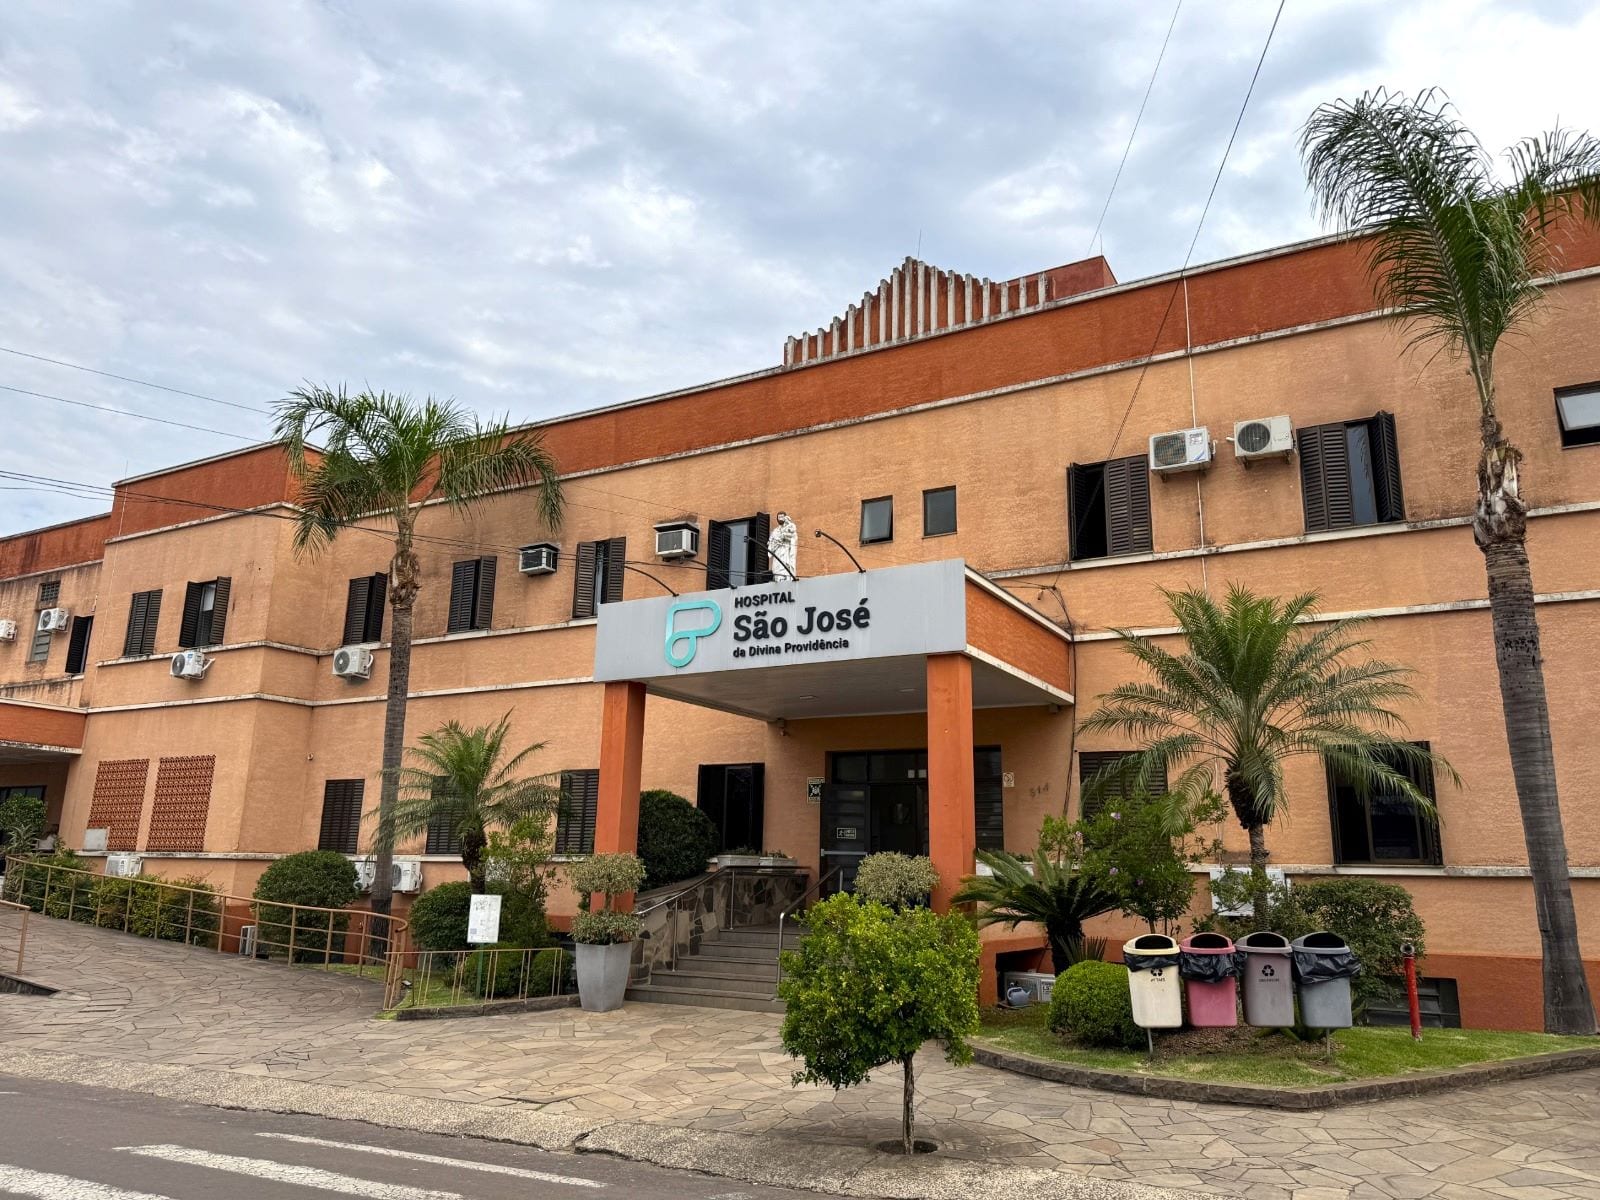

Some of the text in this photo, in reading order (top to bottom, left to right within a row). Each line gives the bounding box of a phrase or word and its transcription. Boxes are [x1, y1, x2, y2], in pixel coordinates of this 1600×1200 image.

[734, 591, 795, 608] HOSPITAL
[733, 597, 871, 642] São José
[732, 637, 850, 658] da Divina Providência
